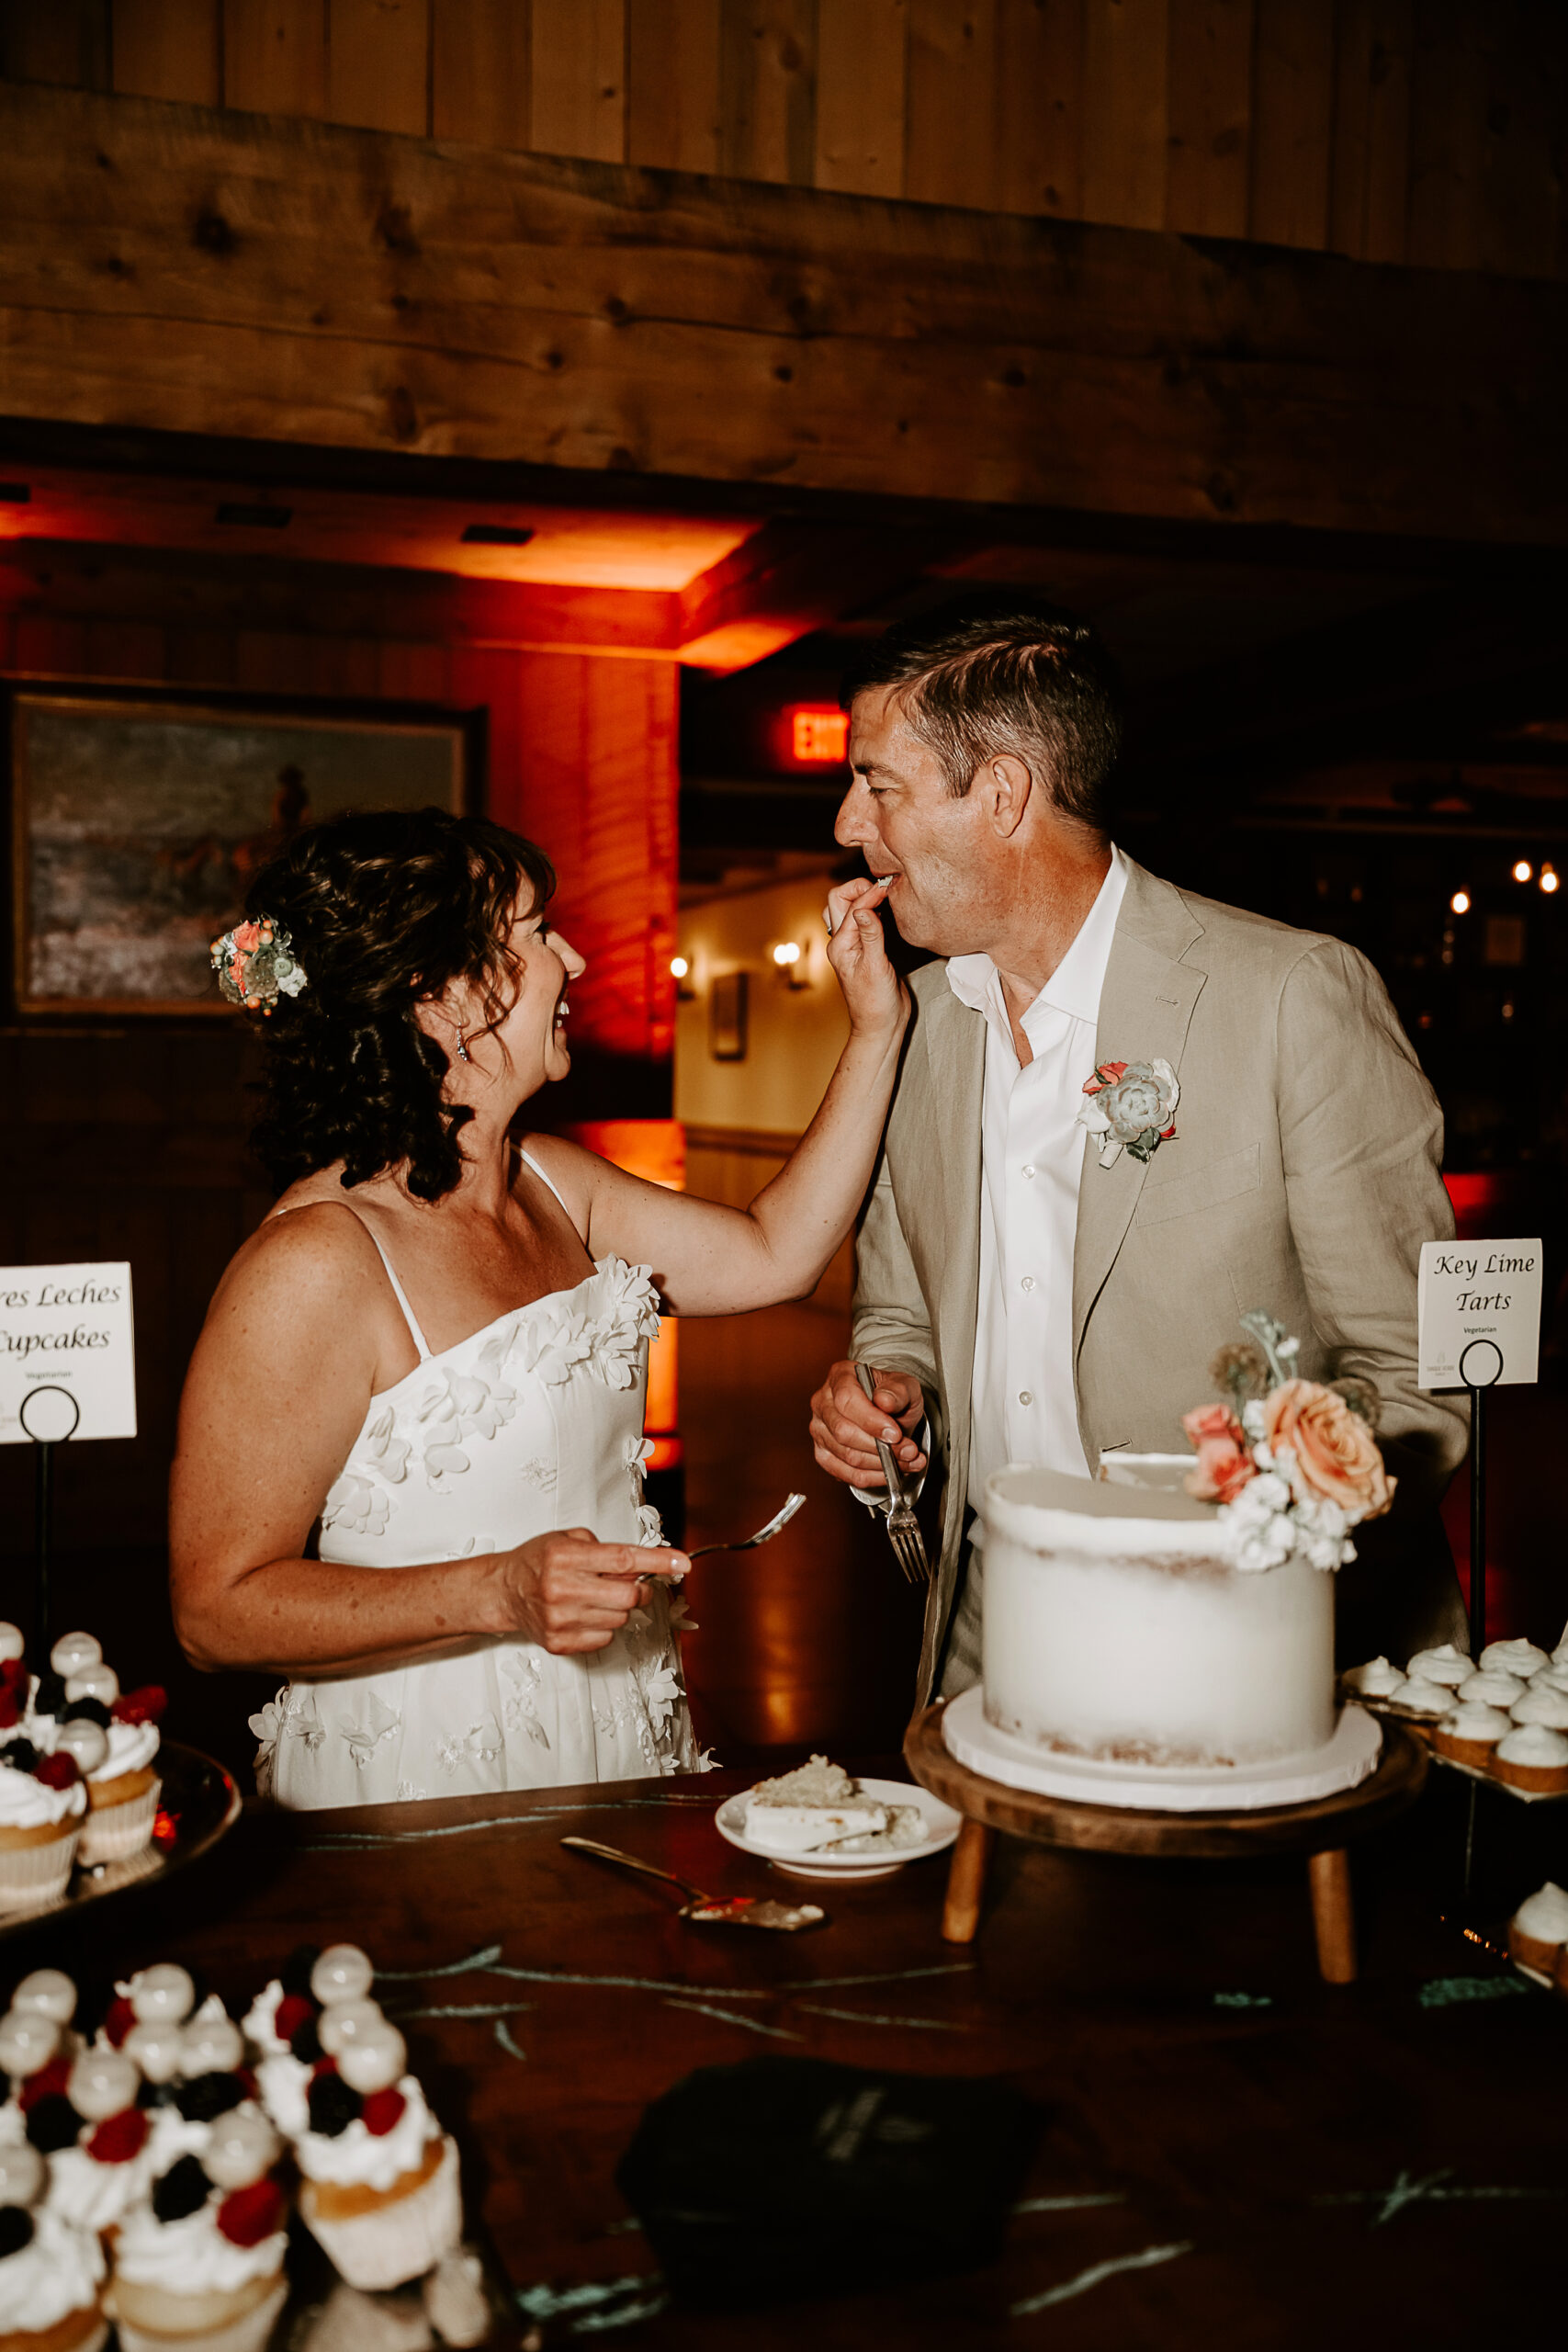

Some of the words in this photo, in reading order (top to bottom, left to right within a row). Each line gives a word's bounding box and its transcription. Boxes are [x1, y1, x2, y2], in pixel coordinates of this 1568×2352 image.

[1434, 1255, 1478, 1281] Key
[1484, 1253, 1535, 1273] Lime
[36, 1278, 121, 1306] Leches
[1456, 1290, 1512, 1311] Tarts
[1463, 1326, 1497, 1334] Vegetarian
